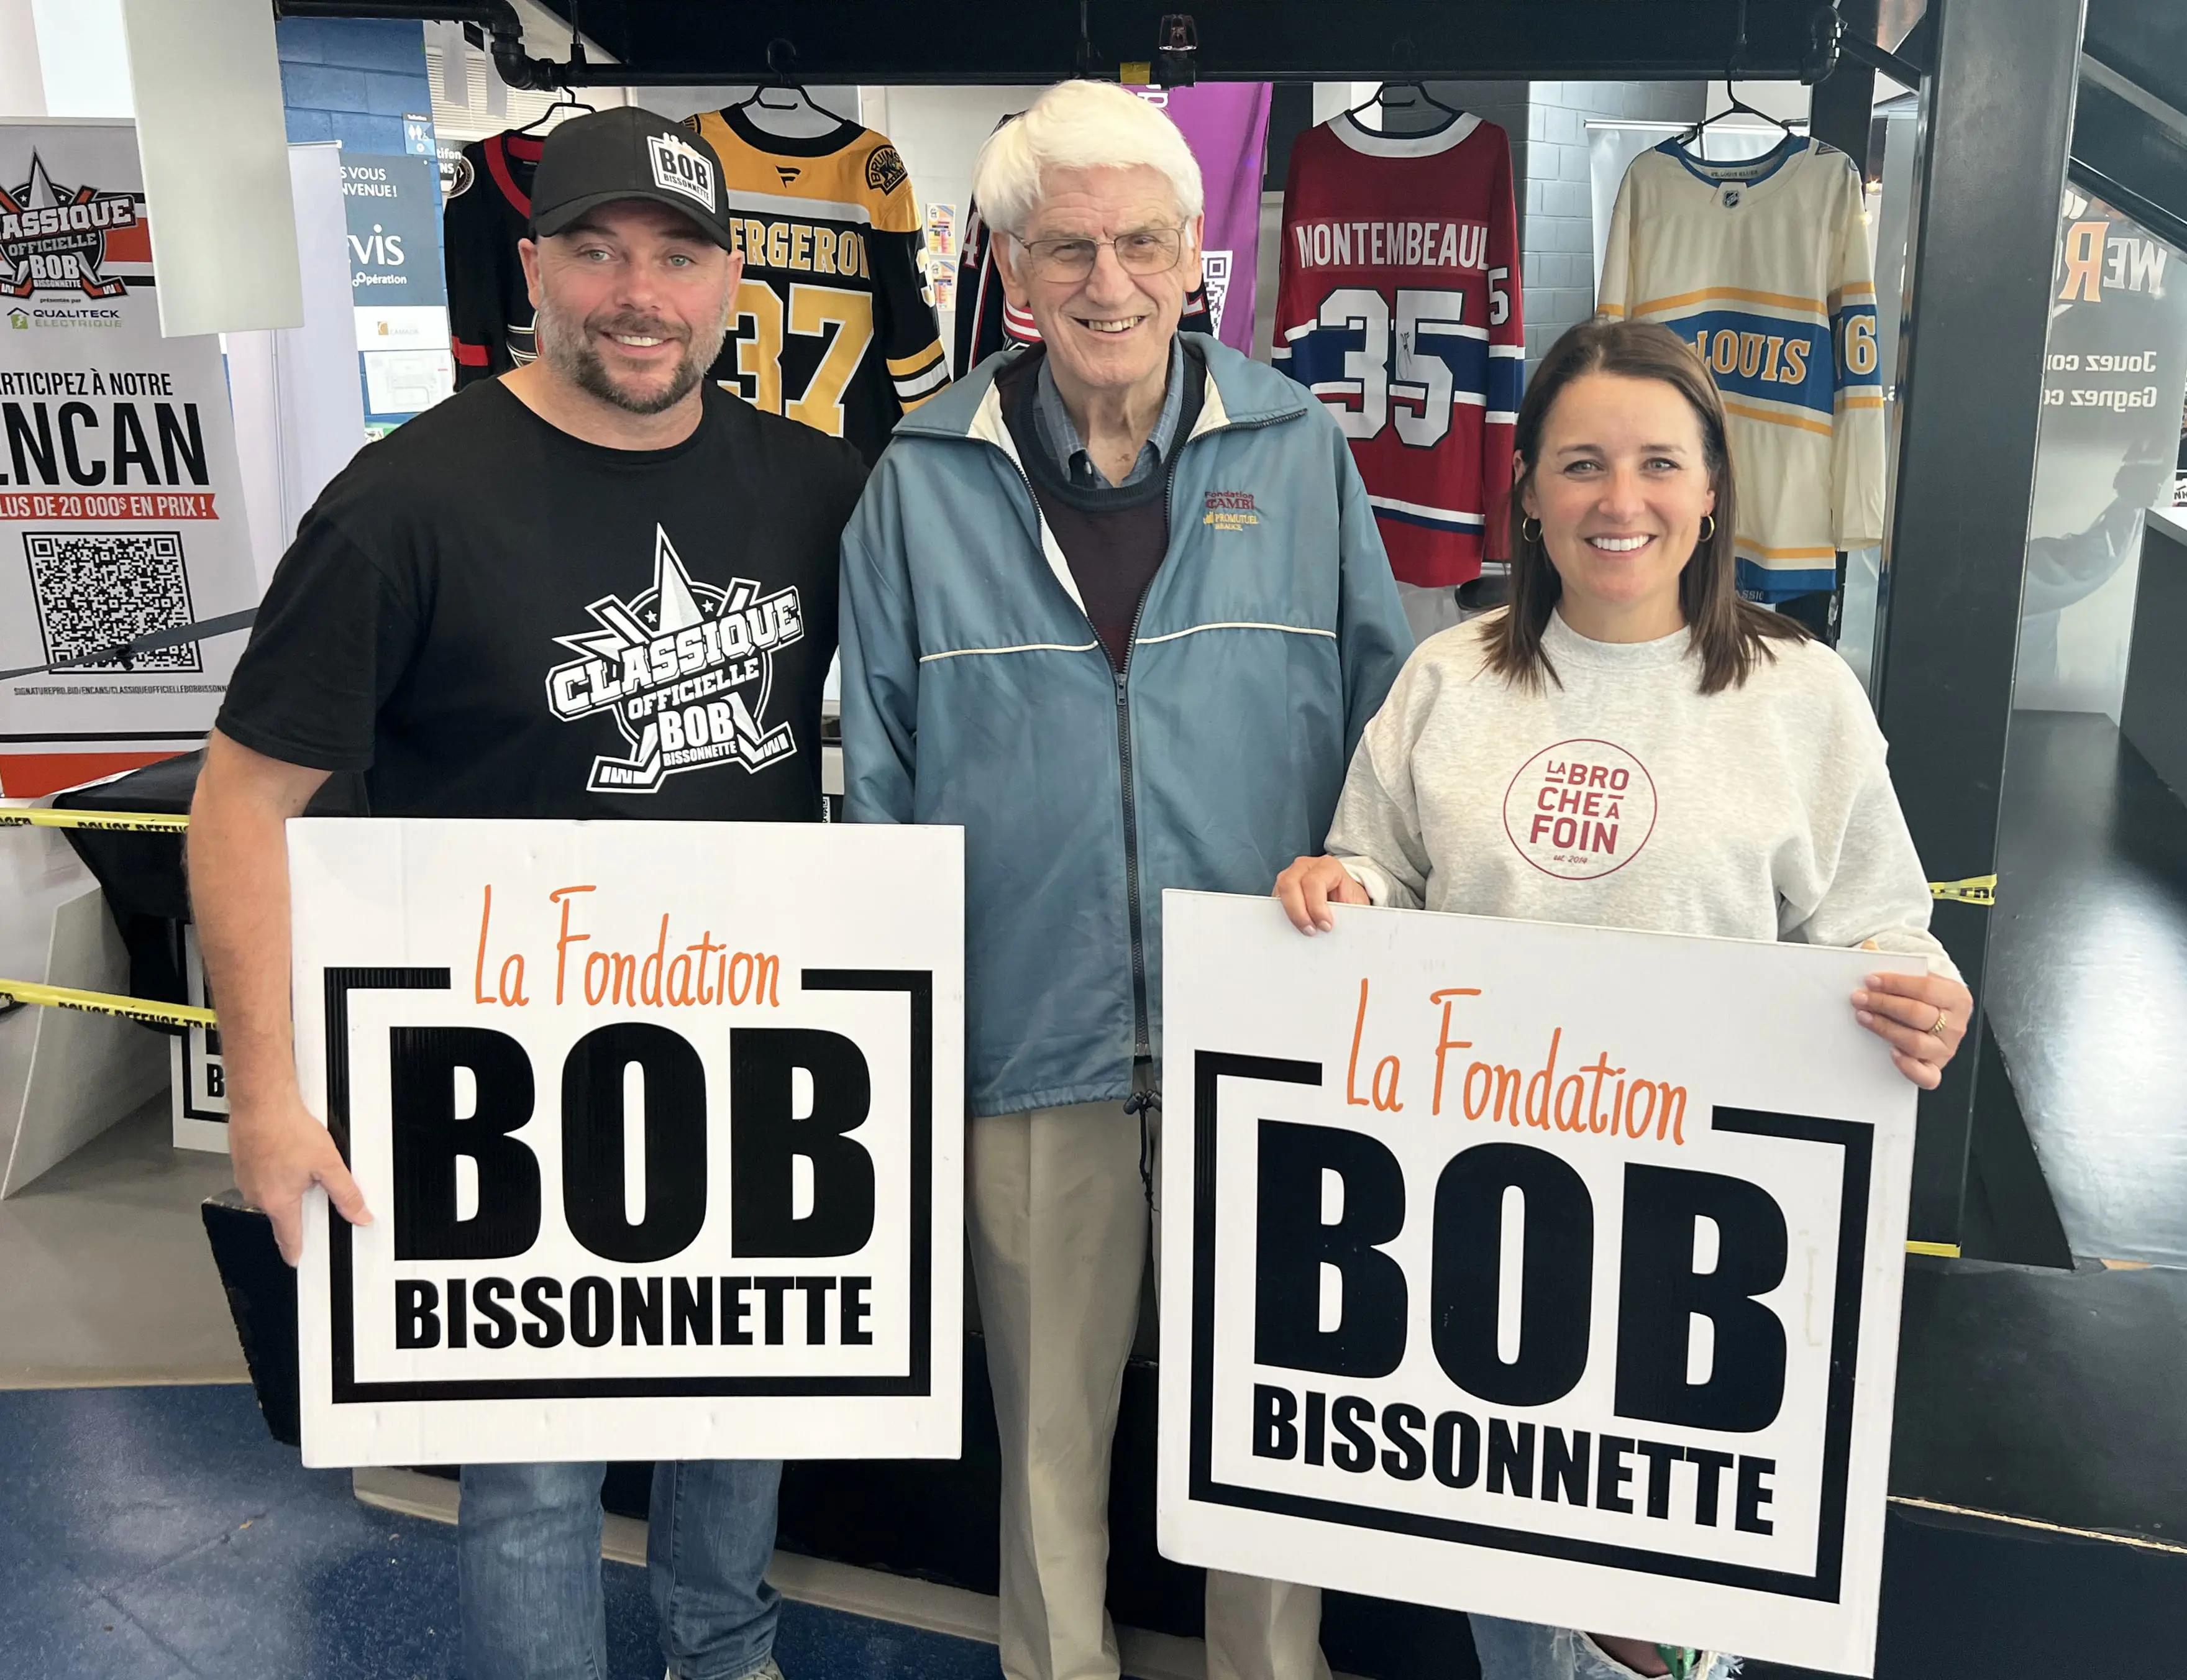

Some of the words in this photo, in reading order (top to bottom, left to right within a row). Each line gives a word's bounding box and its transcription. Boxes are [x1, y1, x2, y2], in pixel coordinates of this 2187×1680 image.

[348, 167, 387, 181] VOUS
[659, 147, 708, 190] BOB
[664, 173, 710, 201] BISSONNETTE
[0, 198, 132, 240] ASSIQUE
[8, 233, 98, 257] OFFICIELLE
[29, 255, 80, 279] BOB
[33, 309, 120, 318] QUALITECK
[717, 278, 874, 438] 37
[1319, 288, 1464, 449] 35
[1696, 329, 1811, 386] LOUIS
[1844, 314, 1878, 375] 6
[89, 367, 107, 396] À
[109, 373, 174, 396] NOTRE
[0, 401, 210, 486] NCAN
[34, 496, 57, 517] DE
[59, 496, 82, 517] 20
[130, 496, 154, 517] EN
[158, 496, 198, 518] PRIX
[552, 591, 803, 714] CLASSIQUE
[628, 657, 760, 720] OFFICIELLE
[657, 699, 735, 752] BOB
[662, 740, 738, 767] BISSONNETTE
[1546, 760, 1566, 775] LA
[1567, 763, 1630, 791] BRO
[1537, 787, 1604, 818] CHE
[1529, 814, 1619, 856] FOIN
[475, 883, 529, 1007] La
[549, 884, 780, 1008] Fondation
[1346, 977, 1404, 1112] La
[1429, 987, 1687, 1145] Fondation
[389, 1021, 875, 1263] BOB
[1253, 1118, 1789, 1434] BOB
[394, 1276, 874, 1349] BISSONNETTE
[1251, 1382, 1776, 1537] BISSONNETTE
